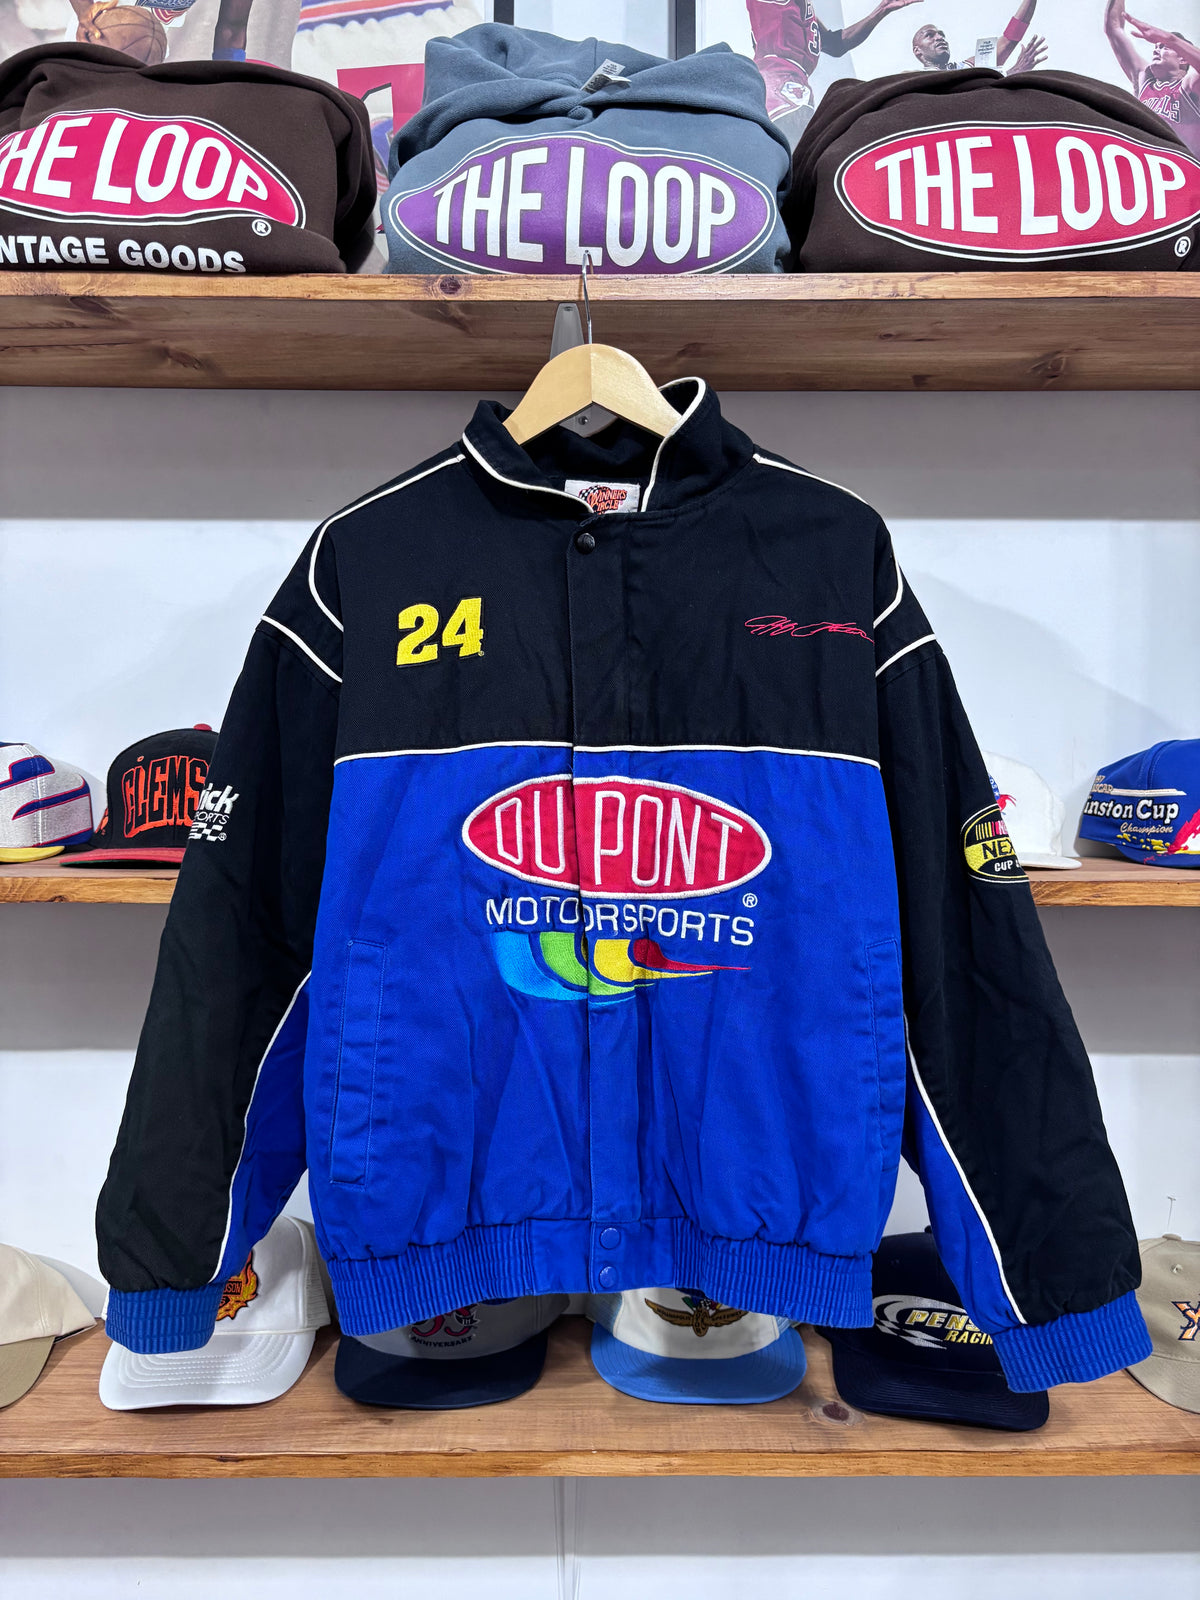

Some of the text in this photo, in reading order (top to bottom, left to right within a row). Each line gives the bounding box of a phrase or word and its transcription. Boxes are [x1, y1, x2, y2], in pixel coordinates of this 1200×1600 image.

[0, 117, 268, 204] HE LOOP
[875, 135, 1186, 236] THE LOOP
[433, 147, 736, 267] THE LOOP
[118, 238, 247, 273] GOODS
[396, 597, 483, 665] 24
[495, 786, 743, 887] DU PONT
[1120, 822, 1173, 835] Champion
[1136, 799, 1179, 824] Cup
[994, 860, 1013, 872] CUP
[486, 895, 754, 946] MOTORSPORTS
[410, 1336, 475, 1348] ANNIVERSARY
